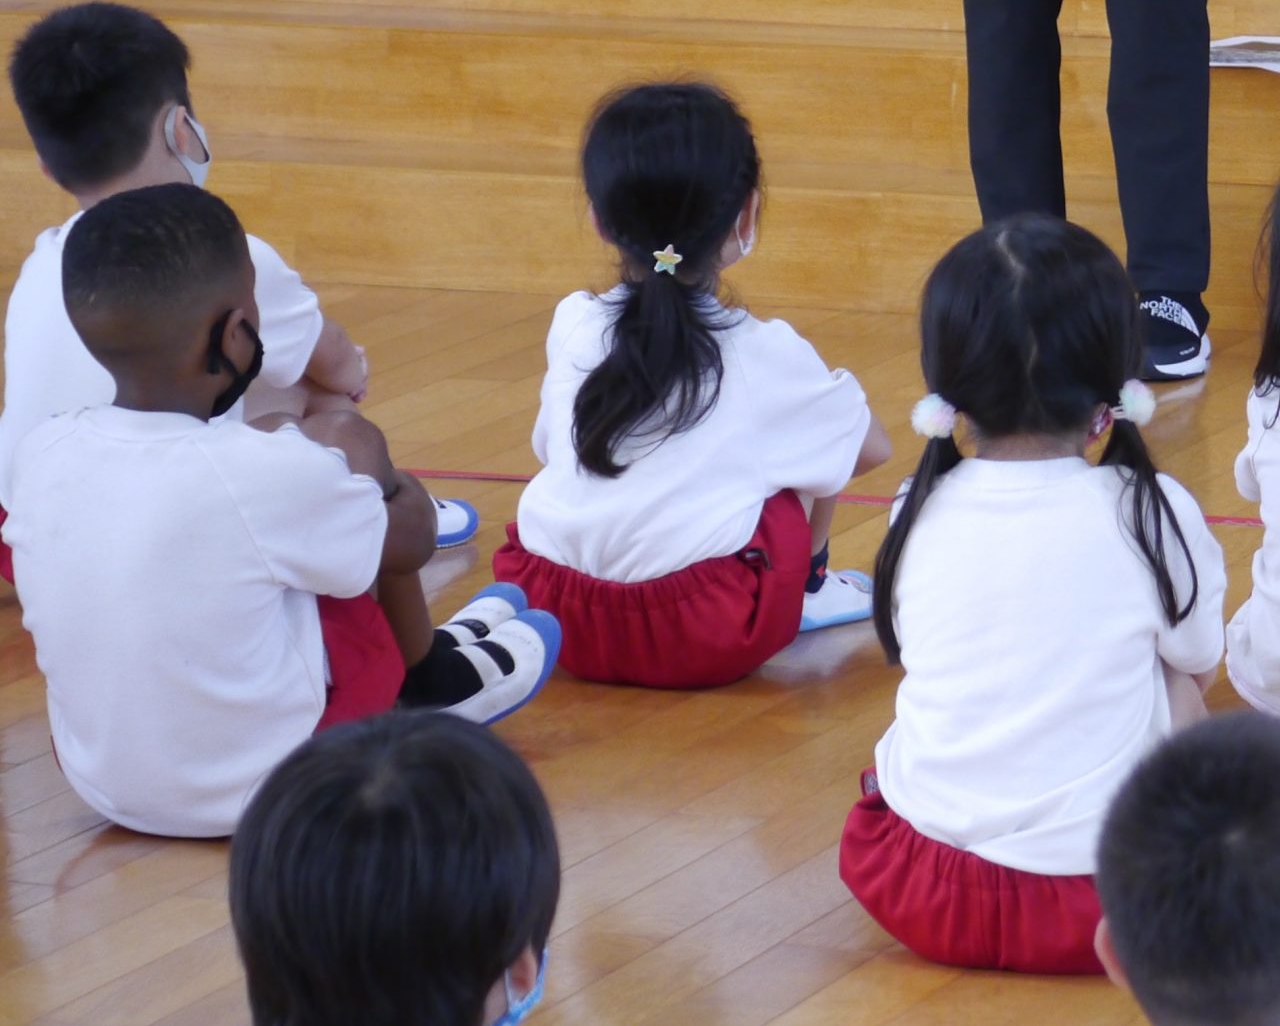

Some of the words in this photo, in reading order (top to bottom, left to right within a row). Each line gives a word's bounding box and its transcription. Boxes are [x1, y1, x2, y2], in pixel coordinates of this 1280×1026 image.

[1139, 300, 1181, 317] NORTH
[1160, 295, 1181, 310] THE
[1150, 308, 1181, 325] FACE
